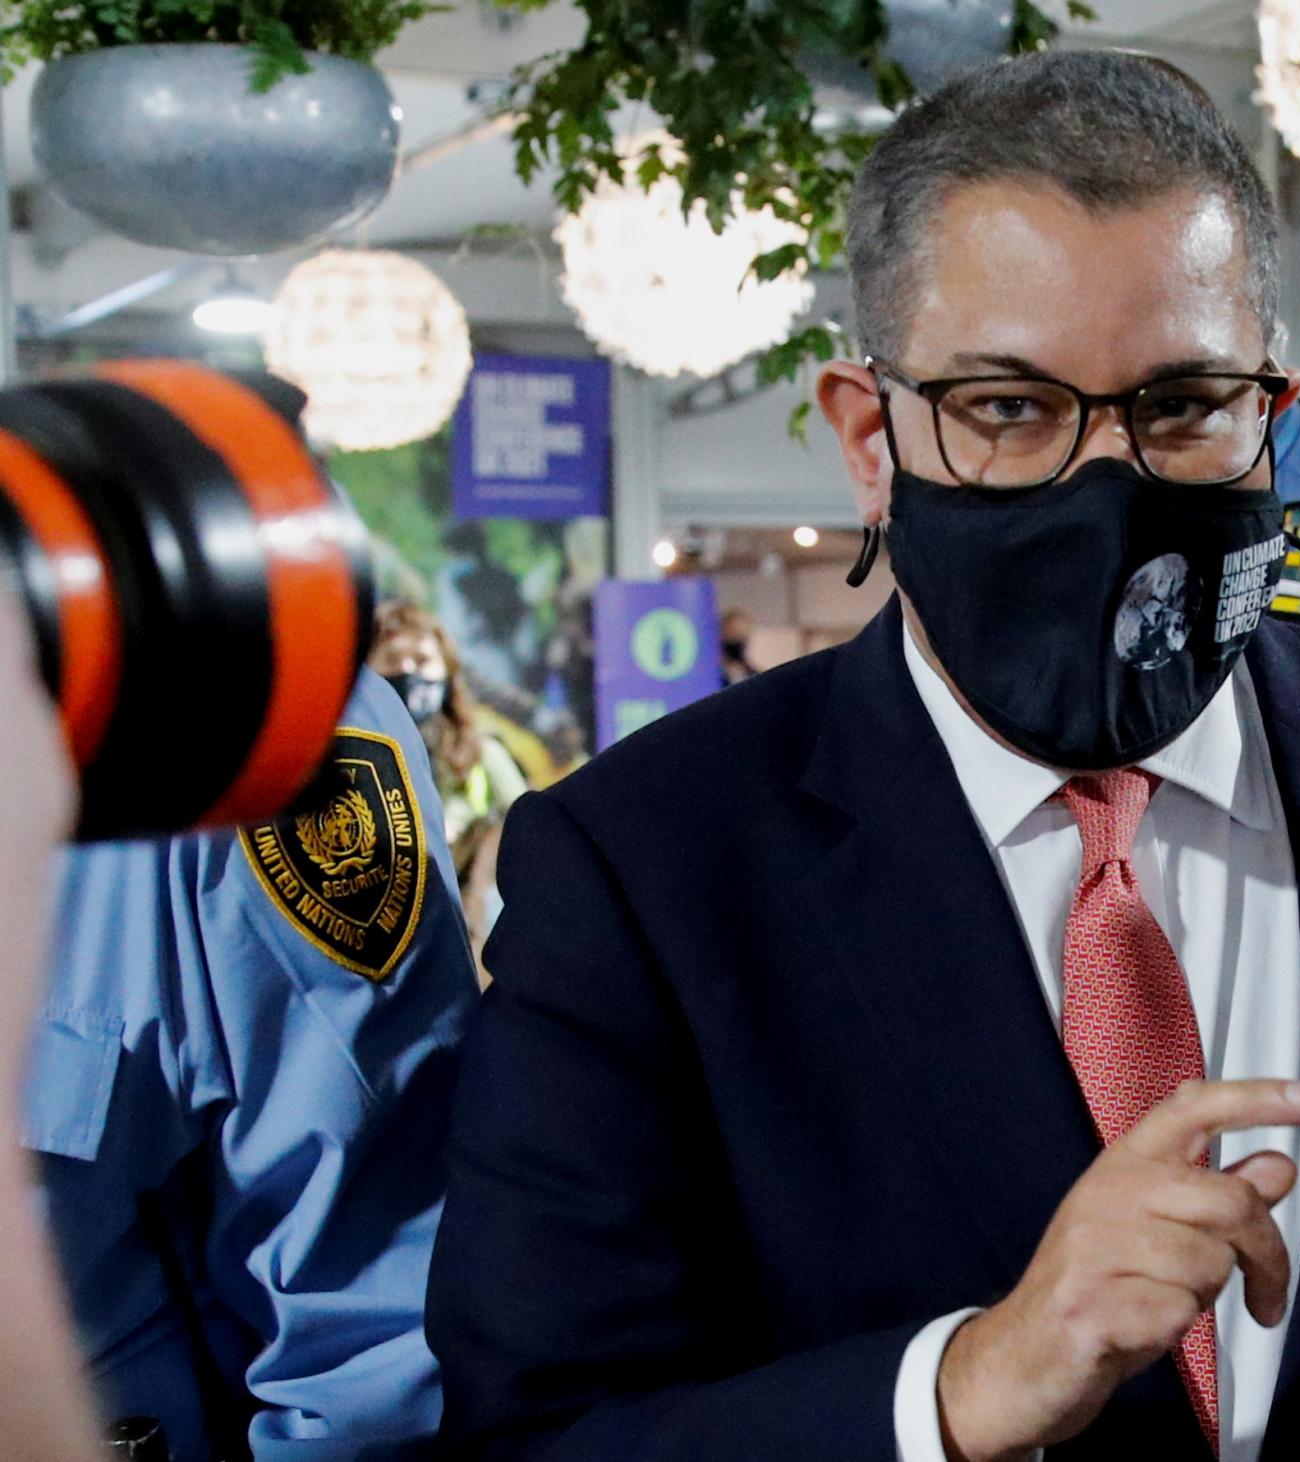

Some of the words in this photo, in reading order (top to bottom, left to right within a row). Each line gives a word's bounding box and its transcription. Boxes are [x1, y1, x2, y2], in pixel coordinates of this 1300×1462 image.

[1222, 550, 1242, 576] UN
[1241, 533, 1286, 572] CLIMATE
[1219, 564, 1268, 598] CHANGE
[1216, 585, 1280, 621] CONFEREN
[1214, 617, 1233, 643] UK
[1231, 608, 1261, 637] 2021
[386, 788, 413, 847] UNIES
[254, 826, 299, 900] UNITED
[296, 894, 366, 951] NATIONS
[376, 854, 413, 934] NATIONS
